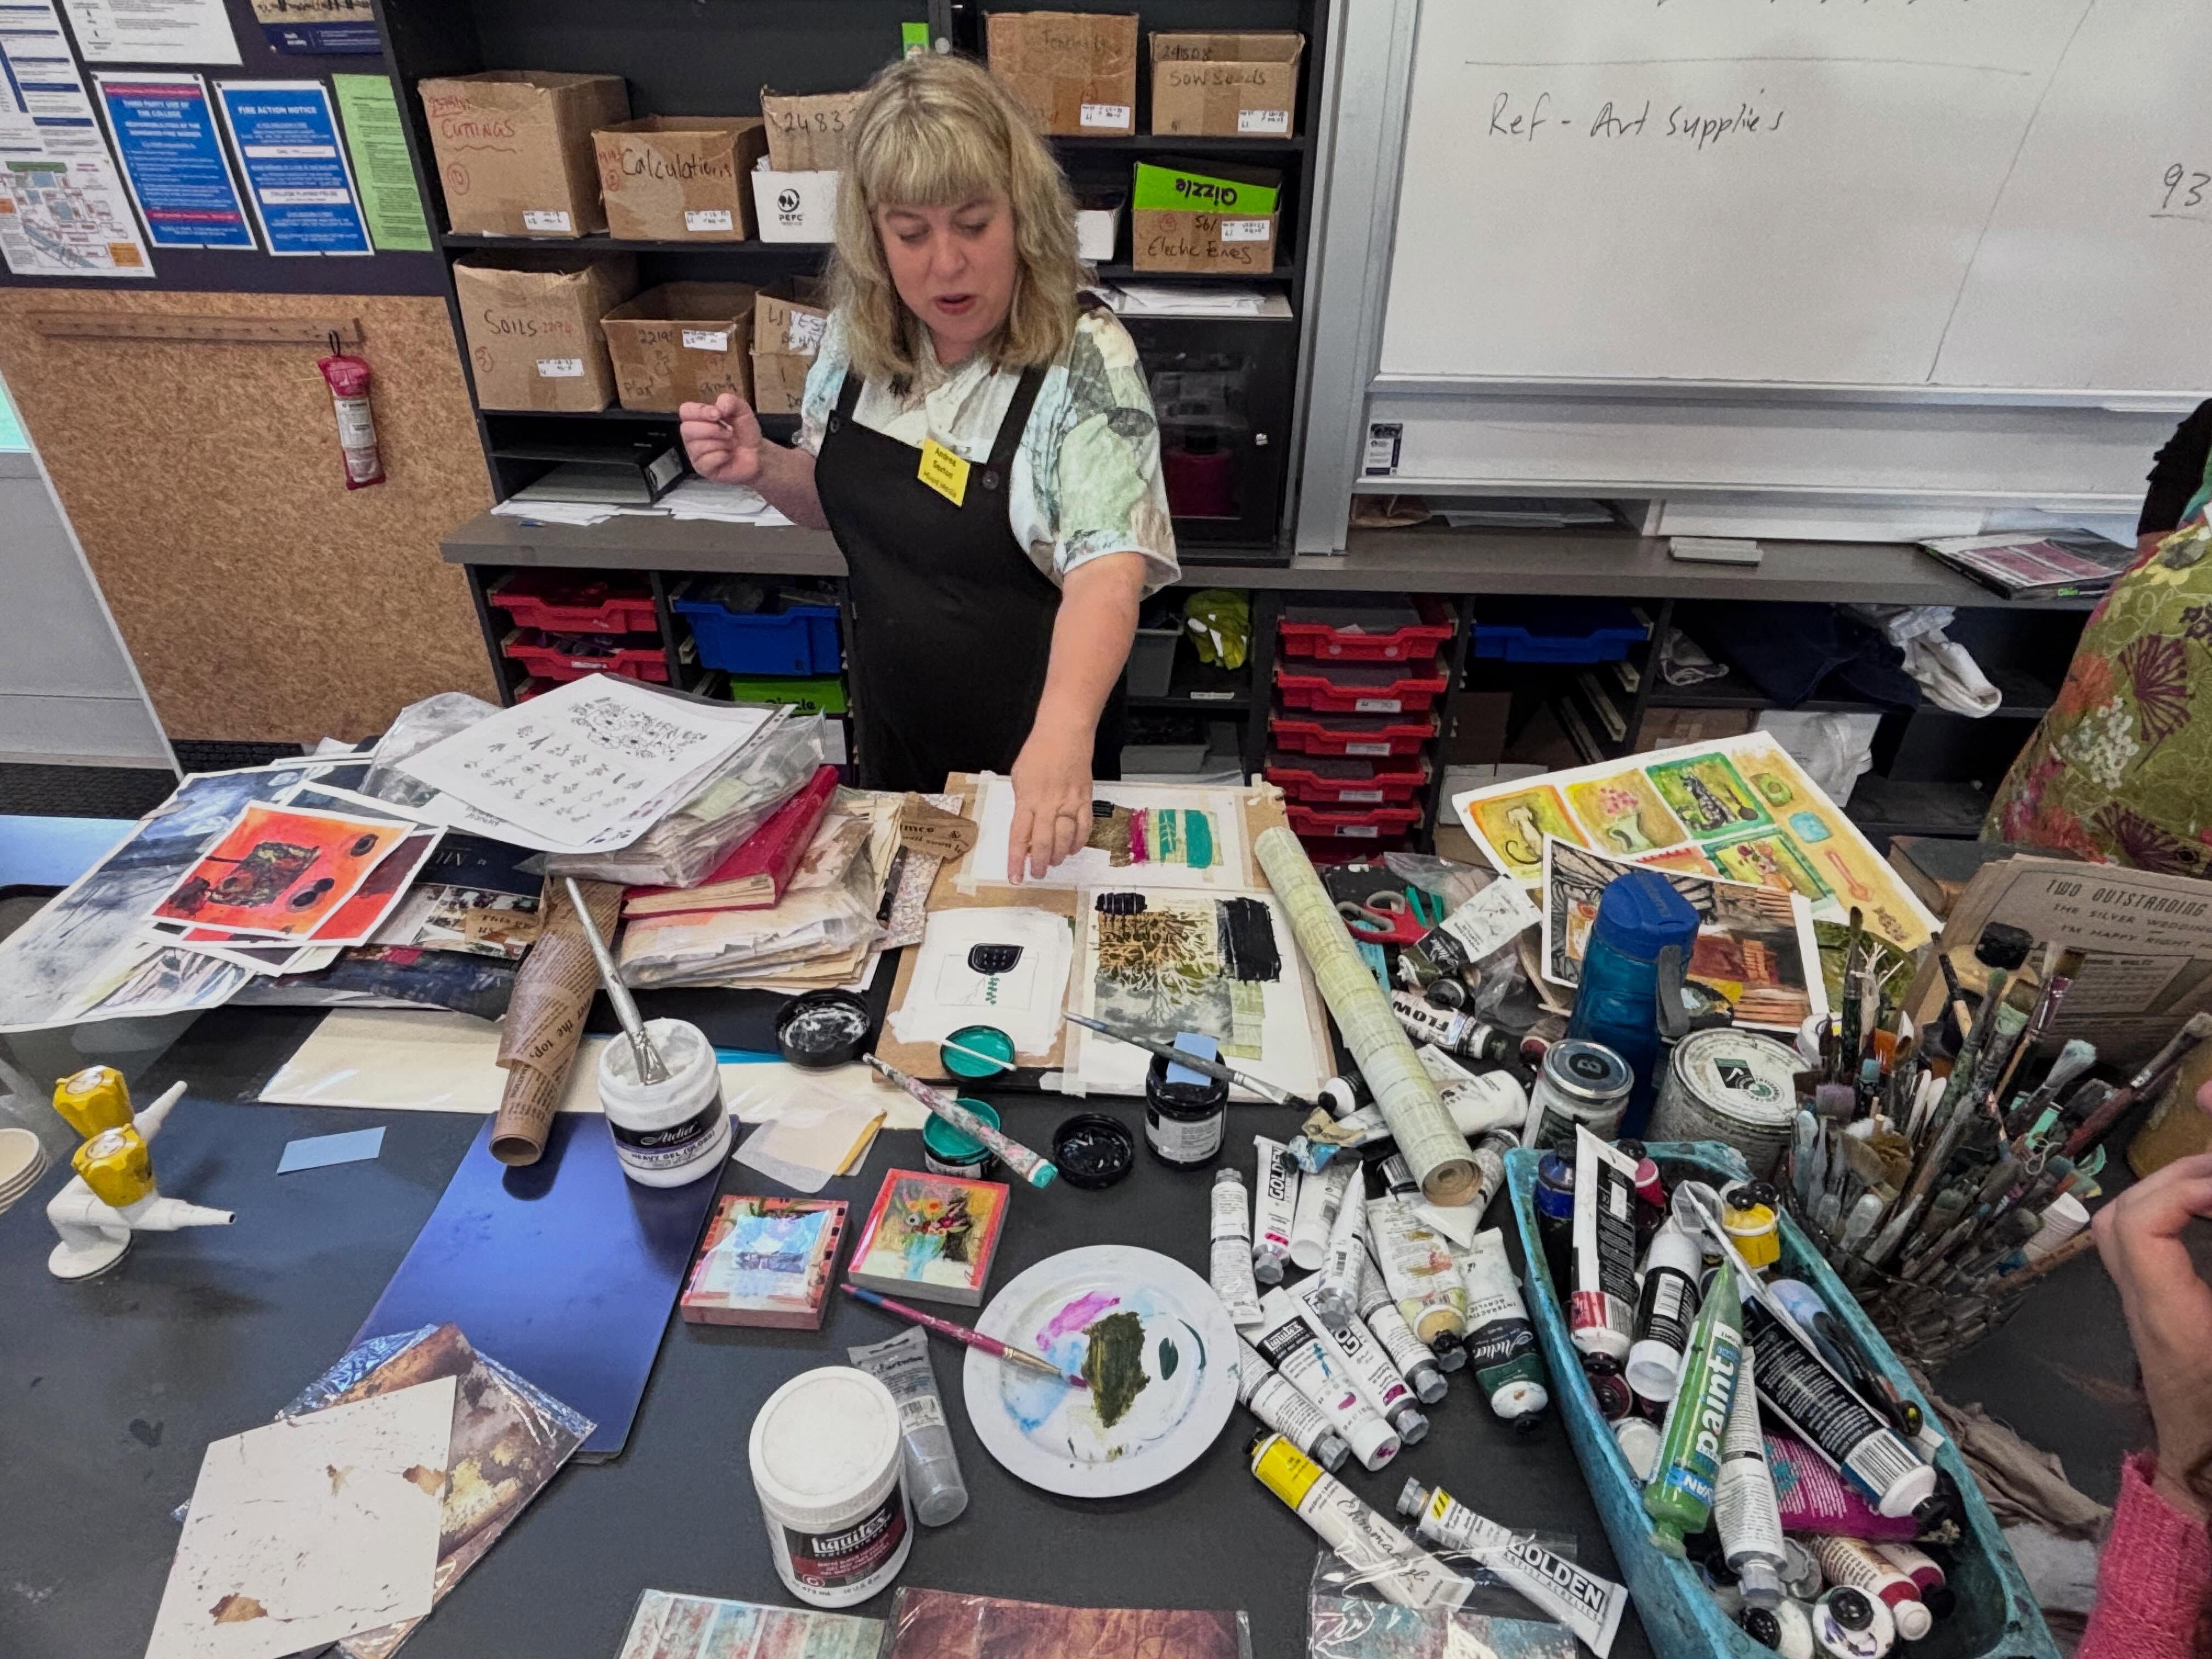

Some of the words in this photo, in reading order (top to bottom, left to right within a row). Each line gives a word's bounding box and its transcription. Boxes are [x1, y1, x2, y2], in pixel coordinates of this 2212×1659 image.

[238, 106, 256, 115] FIRE
[258, 106, 286, 115] ACTION
[287, 106, 318, 115] NOTICE
[1489, 92, 1550, 141] Ref
[1591, 101, 1650, 137] Art
[620, 148, 732, 180] Calculations
[2162, 163, 2211, 208] 93
[2046, 879, 2082, 897] TWO
[2092, 887, 2208, 917] OUTSTANDING
[2053, 903, 2080, 915] THE
[2089, 910, 2136, 923] SILVER
[2089, 930, 2138, 942] HAPPY
[557, 1018, 574, 1038] the
[1393, 1000, 1449, 1033] FLOW
[663, 1152, 680, 1160] GEL
[1468, 1302, 1517, 1319] INTERACTIV
[1470, 1299, 1505, 1313] ACRYLIC
[1695, 1355, 1735, 1455] paint
[811, 1509, 891, 1554] Liquitex
[1508, 1541, 1604, 1612] GOLDEN
